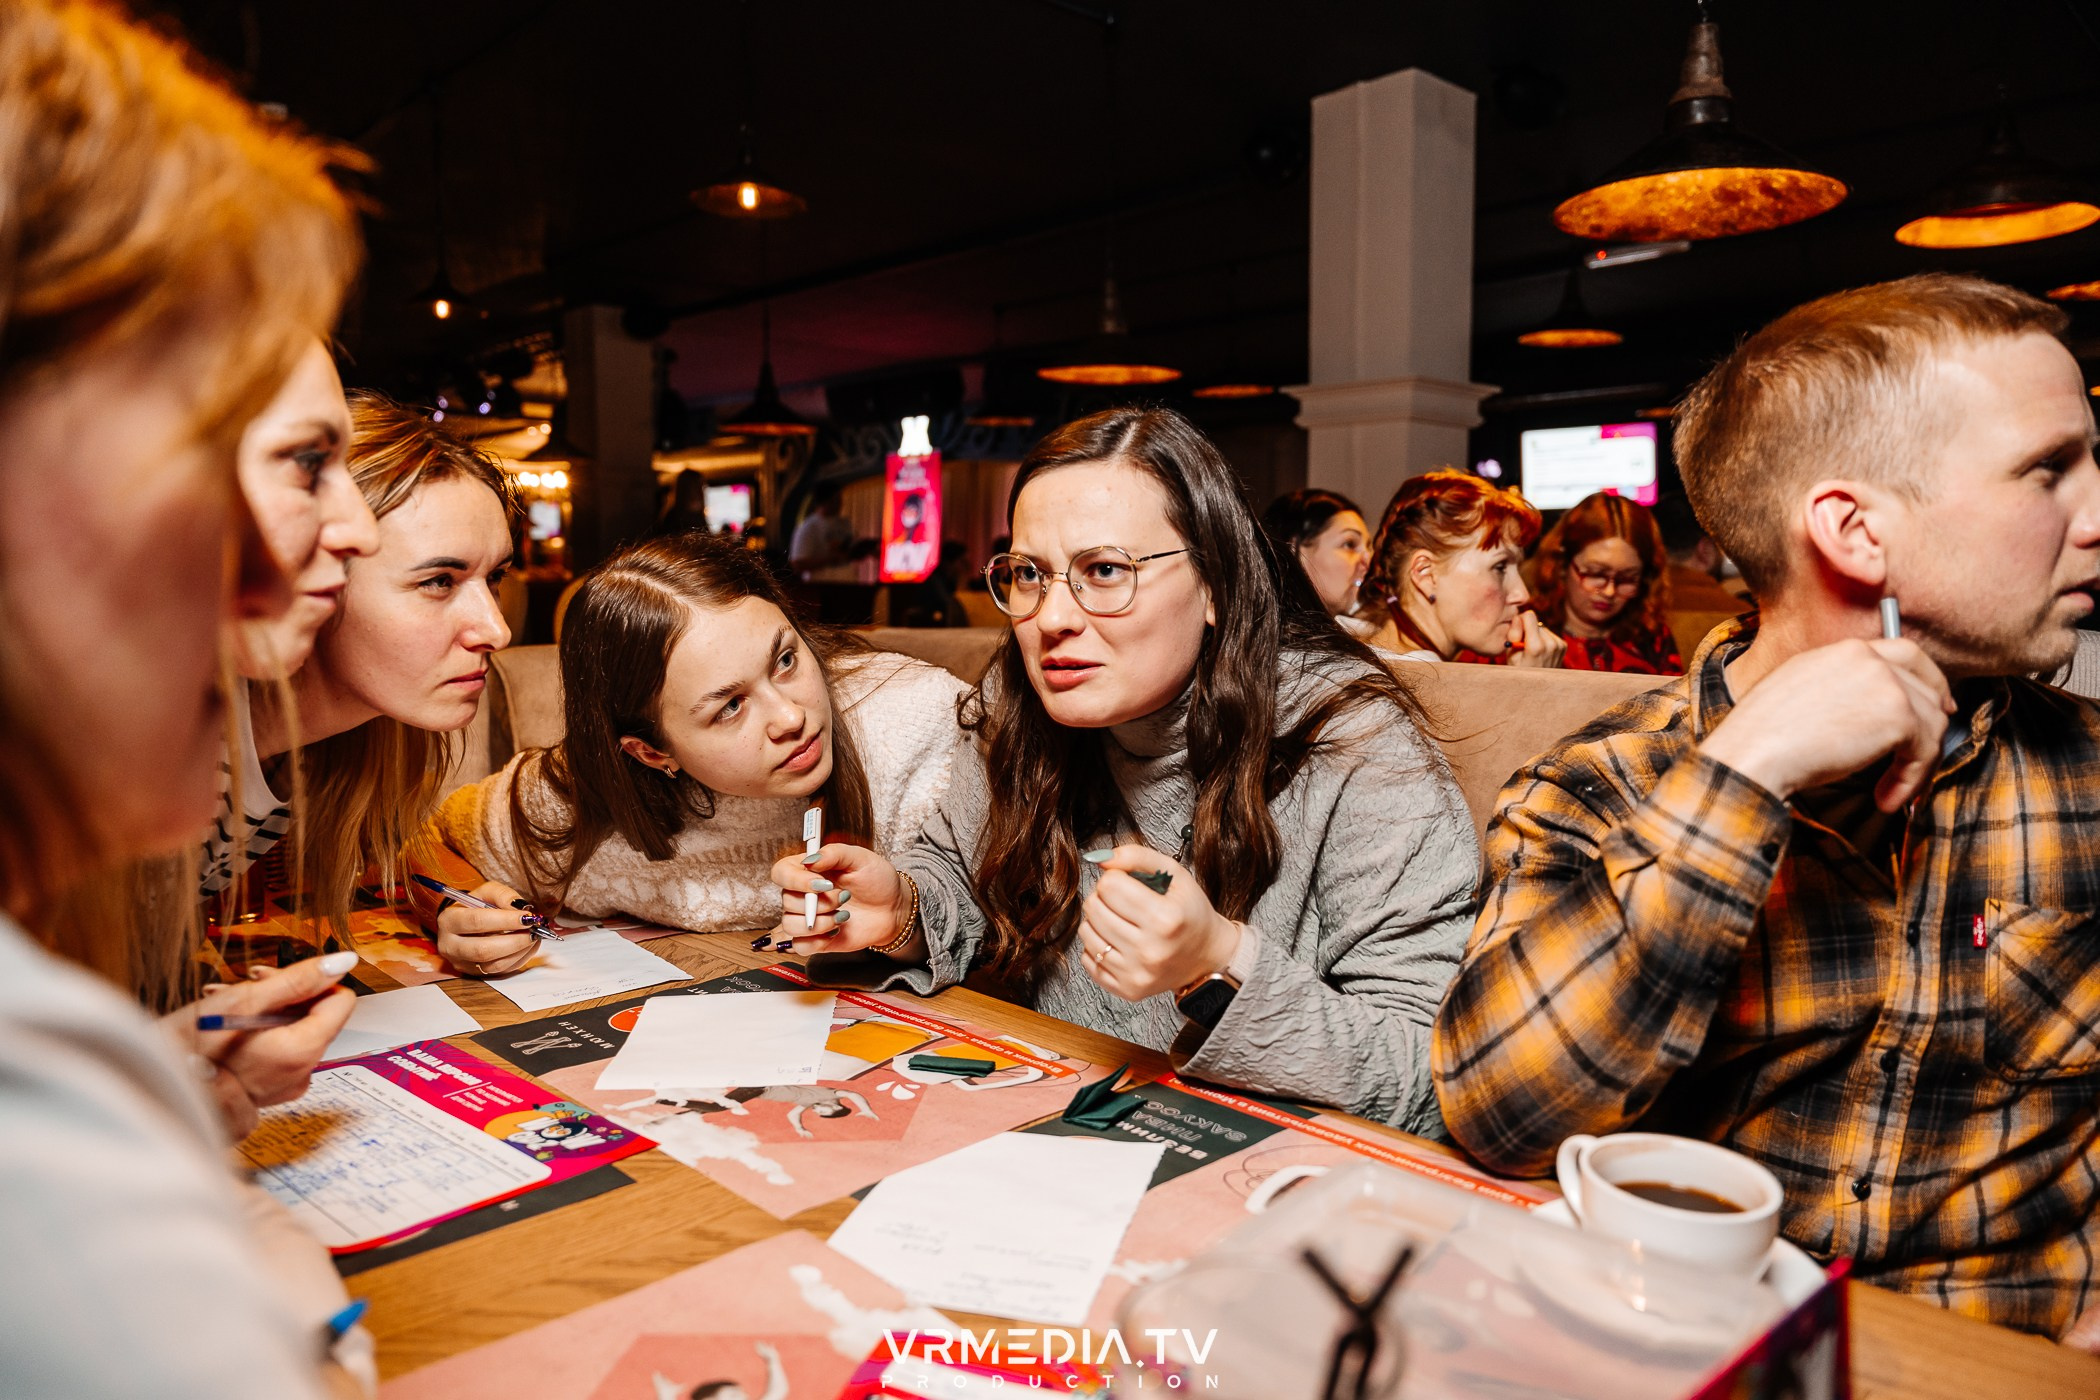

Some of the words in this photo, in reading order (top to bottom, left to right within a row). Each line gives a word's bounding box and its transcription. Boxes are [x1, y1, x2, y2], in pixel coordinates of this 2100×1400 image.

[876, 1005, 945, 1031] безграничных
[558, 1021, 615, 1049] МЮНХЕН
[943, 1028, 967, 1038] дни
[970, 1038, 1005, 1053] среда
[1012, 1053, 1064, 1074] Вторник
[1132, 1110, 1202, 1142] ПИВА
[1143, 1100, 1248, 1142] ЗАКУСО
[1247, 1105, 1355, 1146] удовольствий
[1116, 1121, 1208, 1160] БЕЗЛИМ
